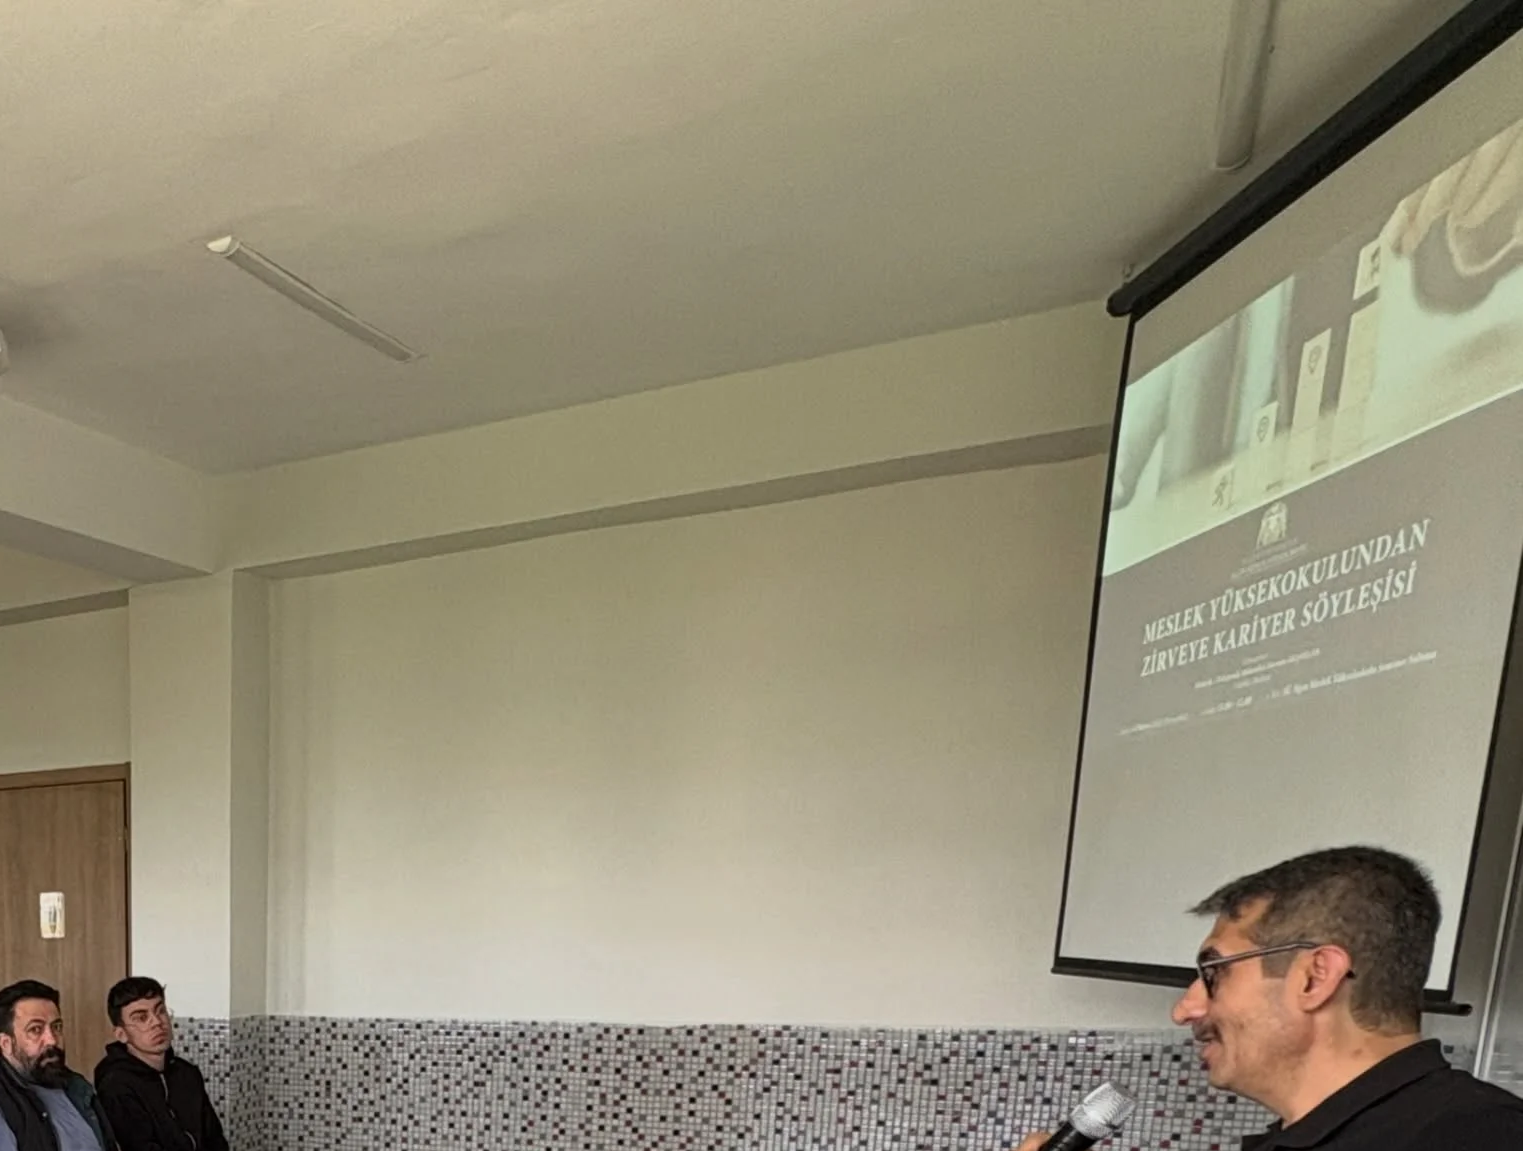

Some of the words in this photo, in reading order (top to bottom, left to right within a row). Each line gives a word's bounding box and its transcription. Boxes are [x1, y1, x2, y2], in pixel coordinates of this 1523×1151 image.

[1140, 636, 1209, 678] ZİRVEYE
[1213, 607, 1296, 656] KARİYER
[1300, 560, 1418, 627] SÖYLEŞİSİ
[1143, 602, 1206, 645] MESLEK
[1208, 518, 1431, 622] YÜKSEKOKULUNDAN
